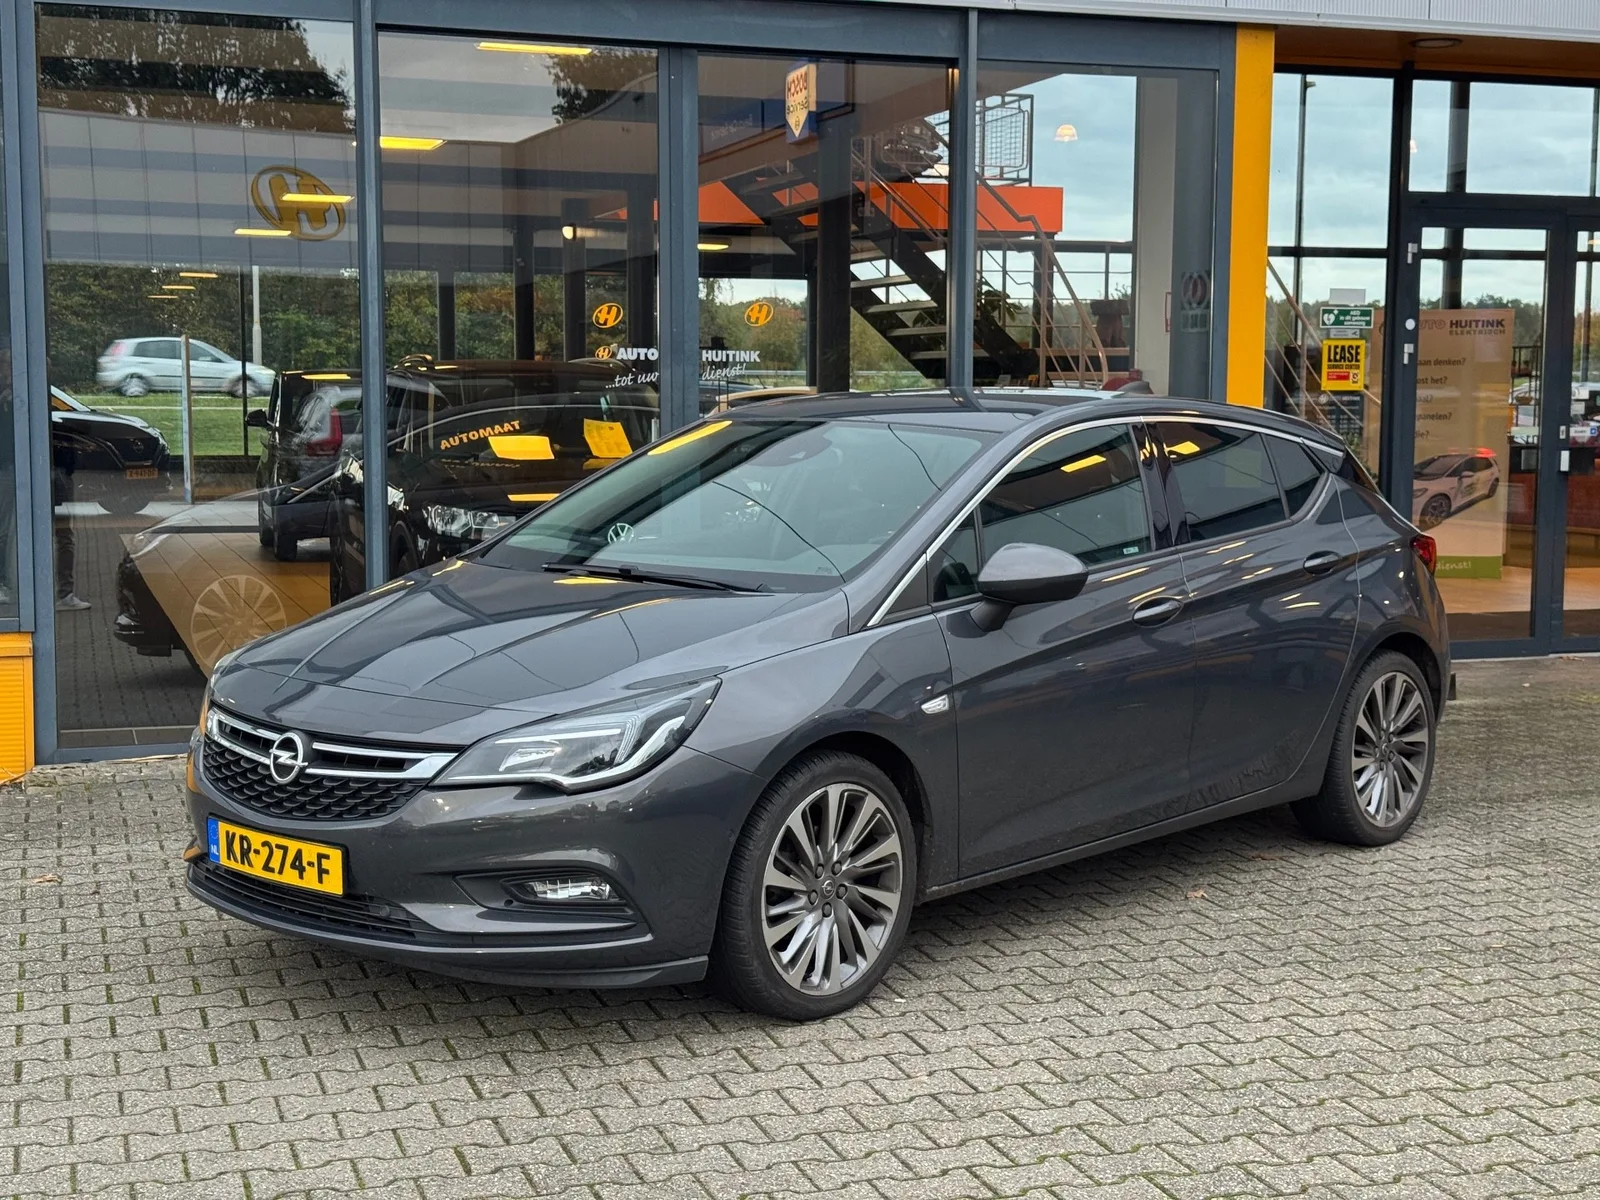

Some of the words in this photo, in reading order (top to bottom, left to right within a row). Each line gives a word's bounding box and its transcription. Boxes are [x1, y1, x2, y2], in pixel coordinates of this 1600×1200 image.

[1419, 319, 1446, 330] UTO
[1449, 319, 1506, 329] HUITINK
[1449, 328, 1506, 336] ELEKTRISCH
[616, 347, 659, 361] AUTO
[702, 349, 760, 362] HUITINK
[1327, 344, 1361, 363] LEASE
[1433, 358, 1466, 367] denken?
[702, 363, 746, 380] dienst!
[1416, 376, 1429, 385] ost
[440, 420, 520, 450] AUTOMAAT
[210, 844, 219, 855] NL
[225, 830, 331, 885] KR-274-F
